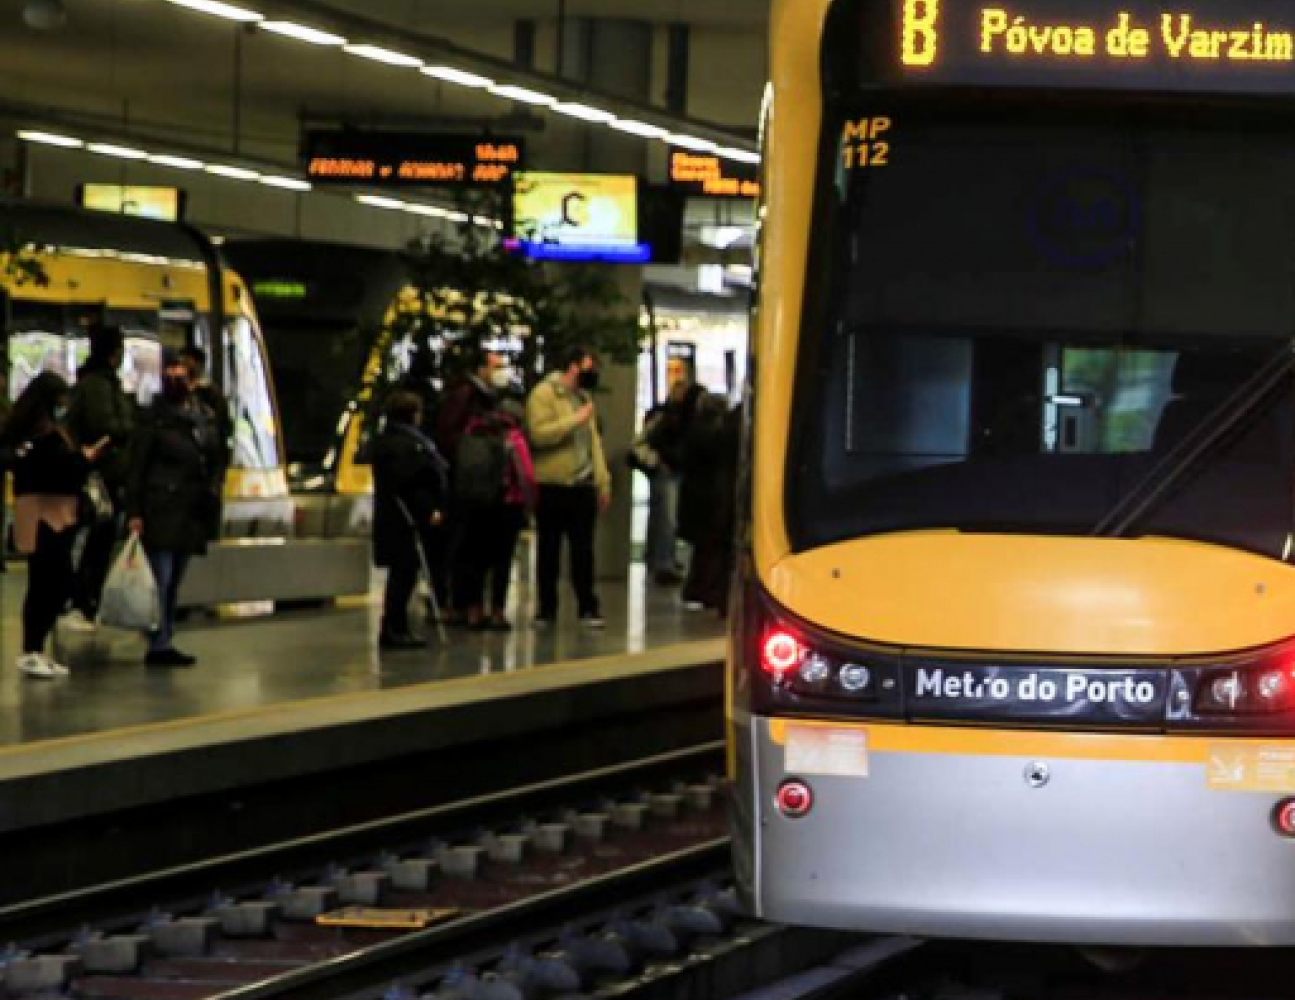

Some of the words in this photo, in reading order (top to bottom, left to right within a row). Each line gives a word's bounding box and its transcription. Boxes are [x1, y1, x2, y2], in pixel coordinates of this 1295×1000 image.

[901, 0, 938, 66] B
[980, 8, 1096, 55] Póvoa
[1105, 12, 1149, 57] de
[1160, 13, 1294, 60] Varzim
[842, 116, 891, 143] MP
[841, 142, 889, 168] 112
[916, 668, 1009, 699] Metro
[1017, 674, 1056, 700] do
[1066, 674, 1154, 702] Porto
